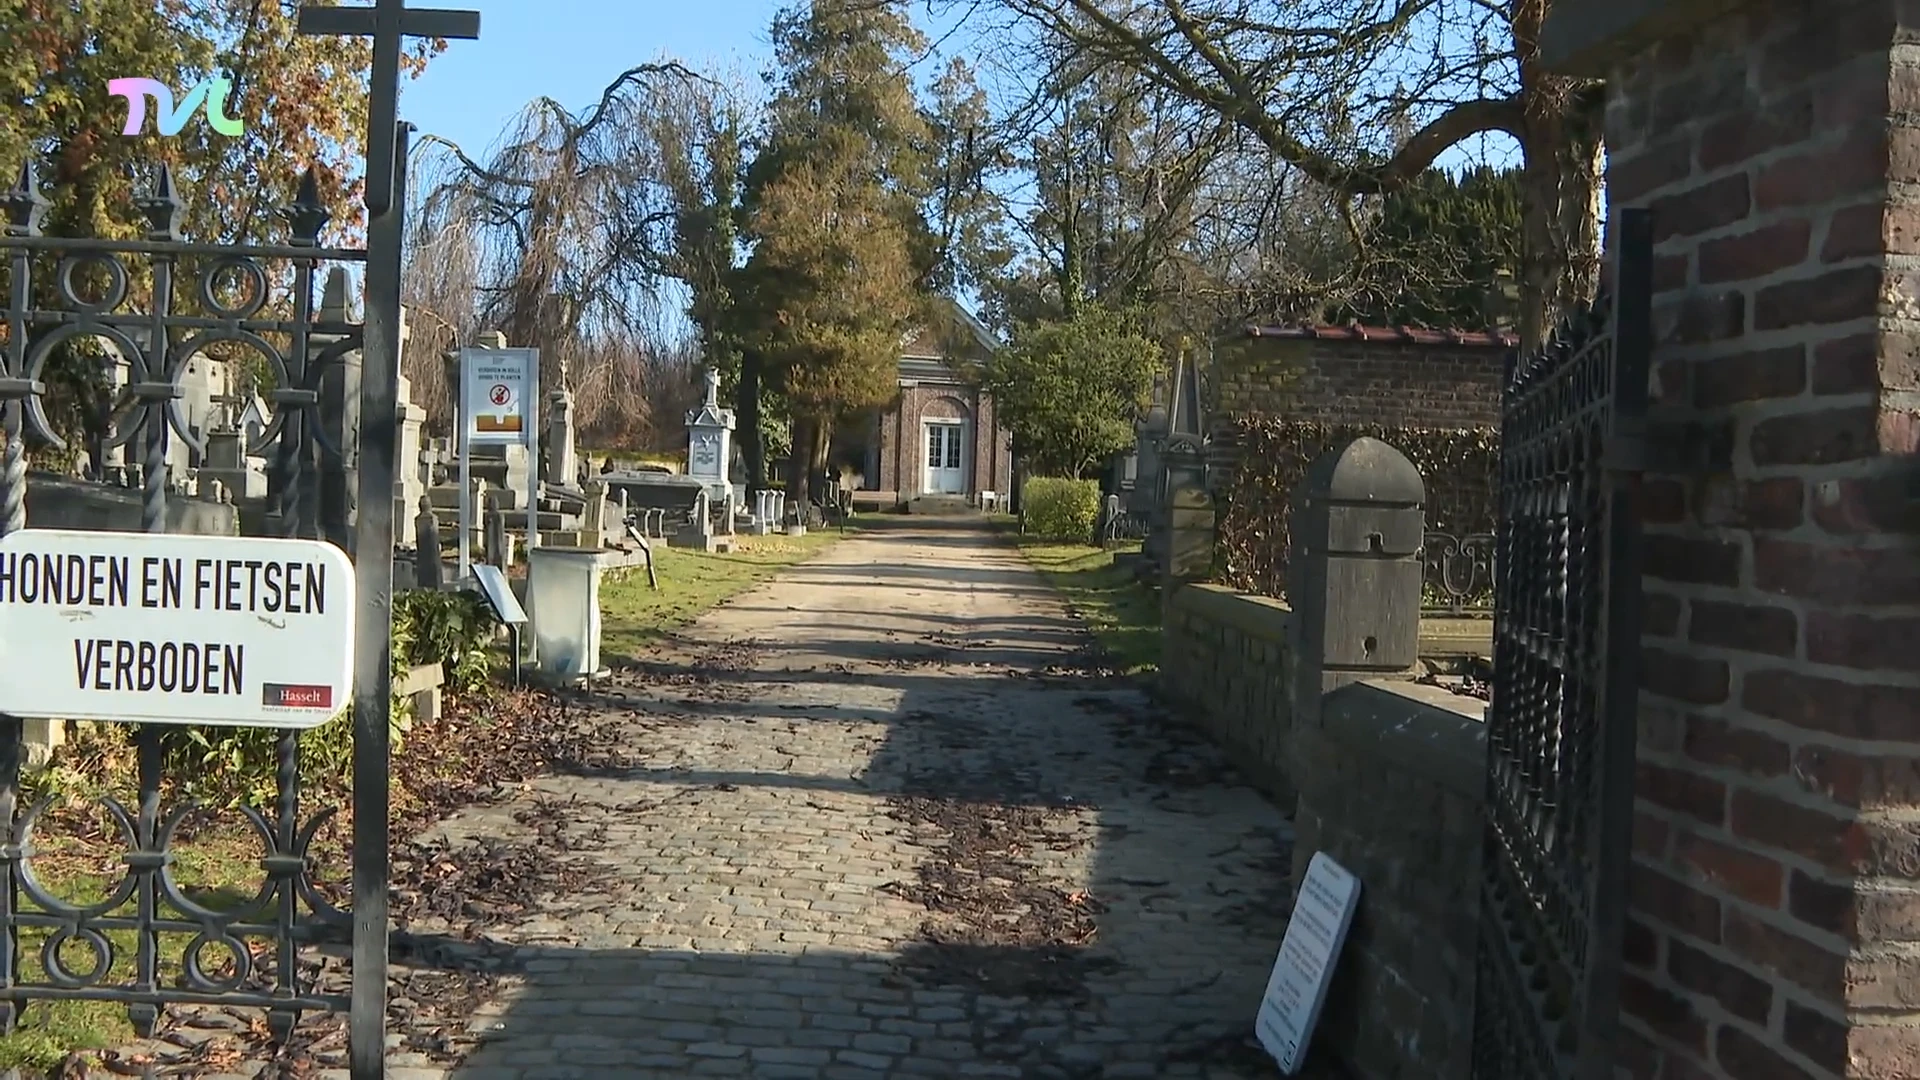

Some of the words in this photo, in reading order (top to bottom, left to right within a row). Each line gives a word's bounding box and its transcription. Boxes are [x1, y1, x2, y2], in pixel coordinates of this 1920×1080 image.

[0, 552, 129, 607] HONDEN
[141, 557, 182, 609] EN
[195, 559, 326, 615] FIETSEN
[74, 638, 244, 695] VERBODEN
[280, 689, 321, 702] Hasselt
